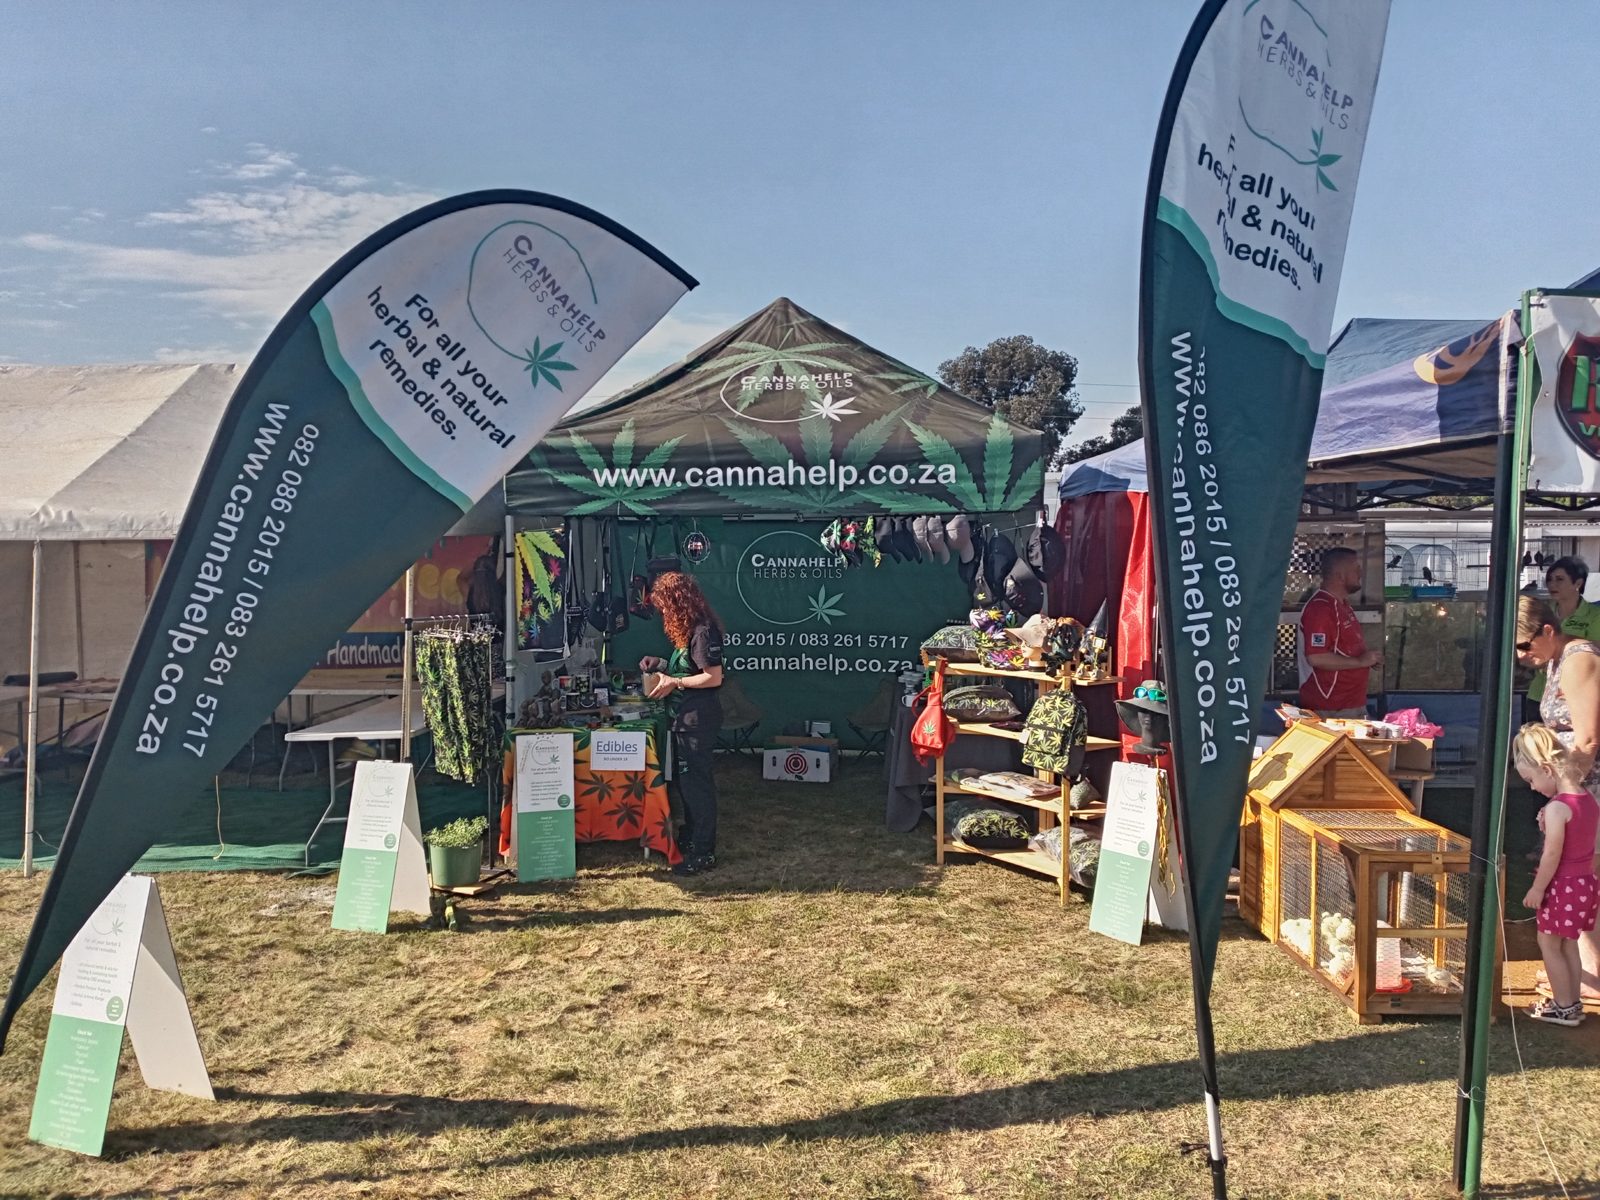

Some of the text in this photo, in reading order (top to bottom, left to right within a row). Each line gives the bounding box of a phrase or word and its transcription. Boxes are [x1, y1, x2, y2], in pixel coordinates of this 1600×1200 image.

[1305, 82, 1317, 99] &
[1239, 172, 1273, 198] all
[1241, 205, 1262, 231] &
[503, 249, 597, 353] HERBS & OILS
[513, 235, 606, 341] CANNAHELP
[367, 285, 516, 449] herbal & natural
[404, 293, 508, 408] For all your
[369, 338, 457, 441] remedies.
[742, 379, 853, 391] HERBS & OILS
[1193, 404, 1212, 456] 086
[592, 458, 957, 492] www.cannahelp.co.za
[1199, 463, 1227, 532] 2015
[751, 553, 842, 567] CANNAHELP
[1171, 331, 1218, 764] www.cannahelp.co.za
[136, 402, 290, 754] www.cannahelp.co.za
[183, 424, 319, 757] 082 086 2015 / 083 261 5717
[753, 568, 842, 579] HERBS & OILS
[1215, 556, 1241, 607] 083
[326, 635, 405, 665] Handmad
[746, 633, 786, 646] 2015
[790, 633, 795, 646] /
[799, 633, 829, 646] 083
[833, 634, 862, 647] 261
[868, 635, 909, 649] 5717
[1225, 616, 1241, 665] 261
[1225, 677, 1250, 745] 5717
[596, 741, 638, 752] Edibles
